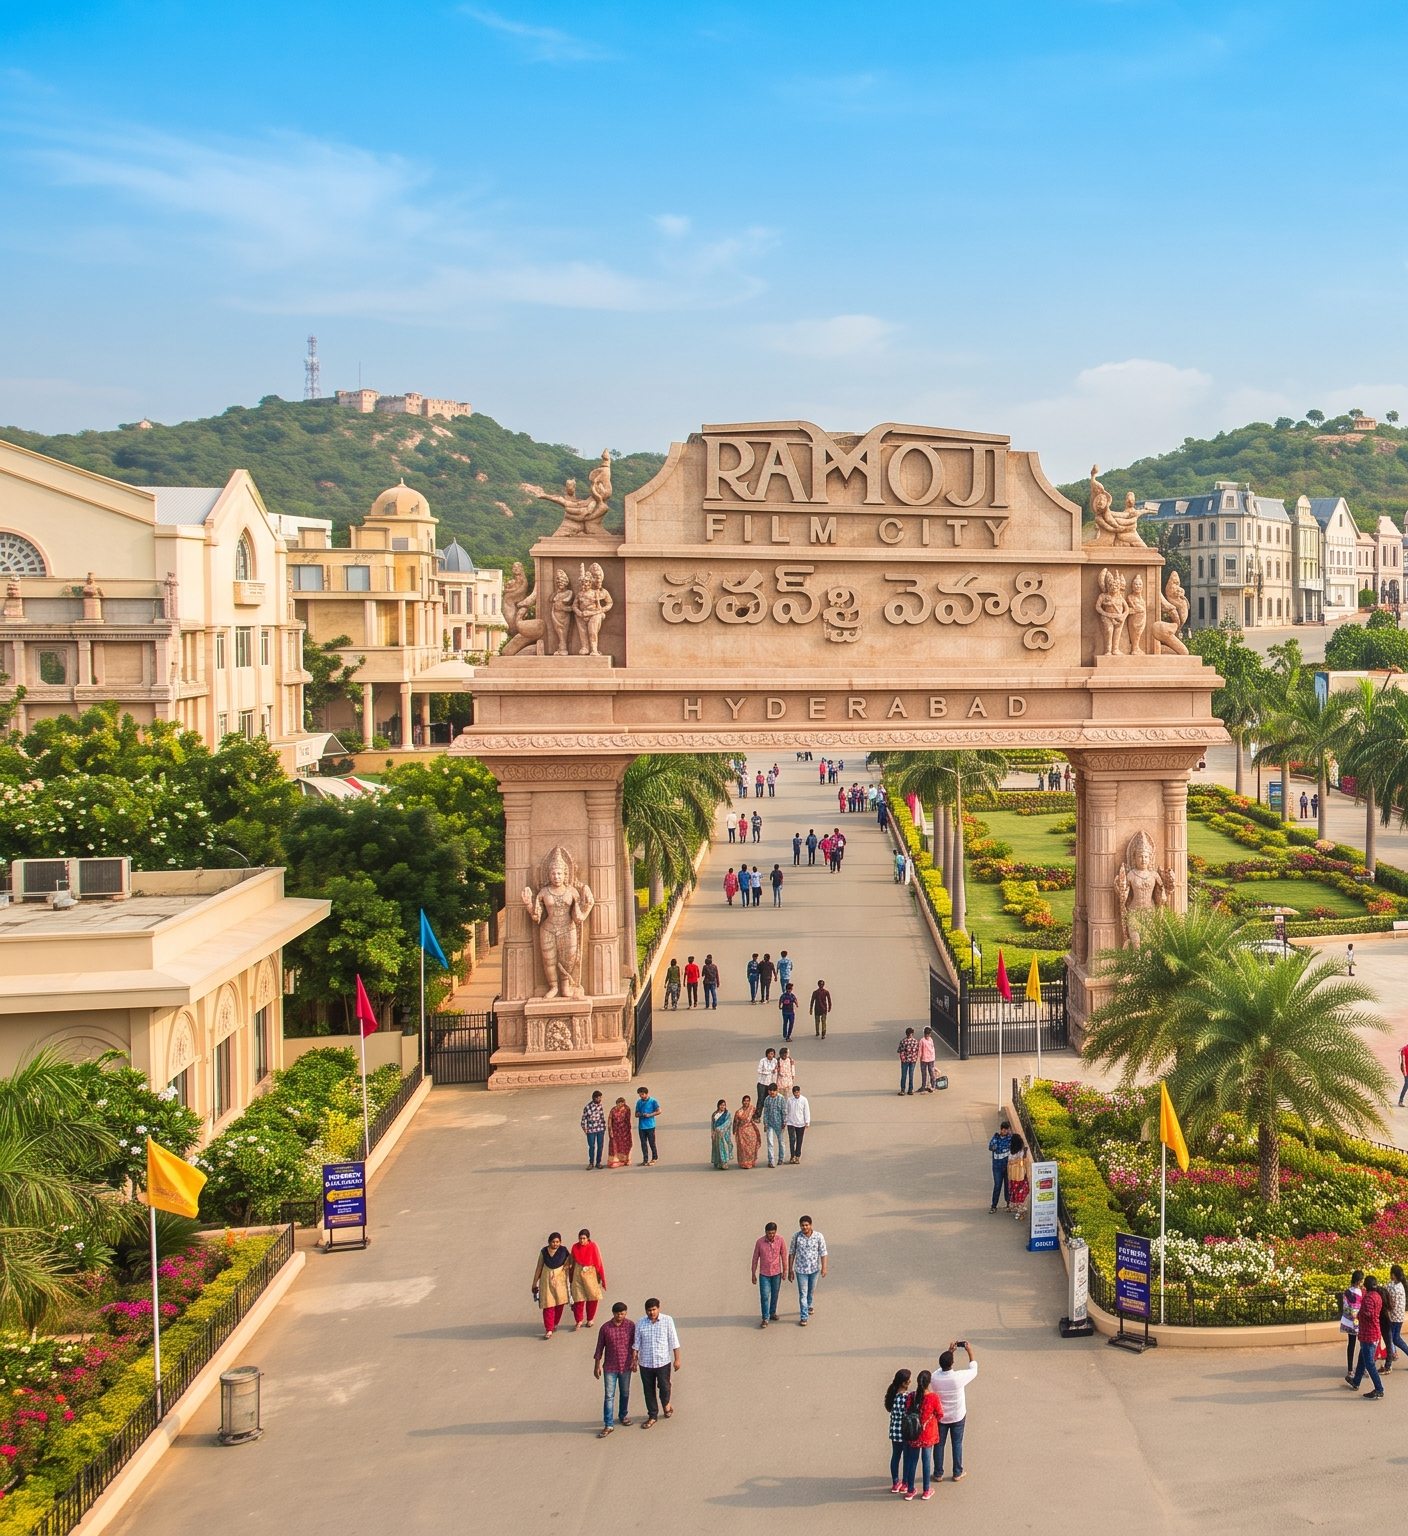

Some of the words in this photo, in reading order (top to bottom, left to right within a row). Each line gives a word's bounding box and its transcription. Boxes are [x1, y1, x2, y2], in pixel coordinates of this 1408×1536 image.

[703, 424, 1010, 508] RAMOJI
[706, 514, 838, 545] FILM
[878, 517, 1010, 547] CITY
[683, 695, 1029, 720] HYDERABAD
